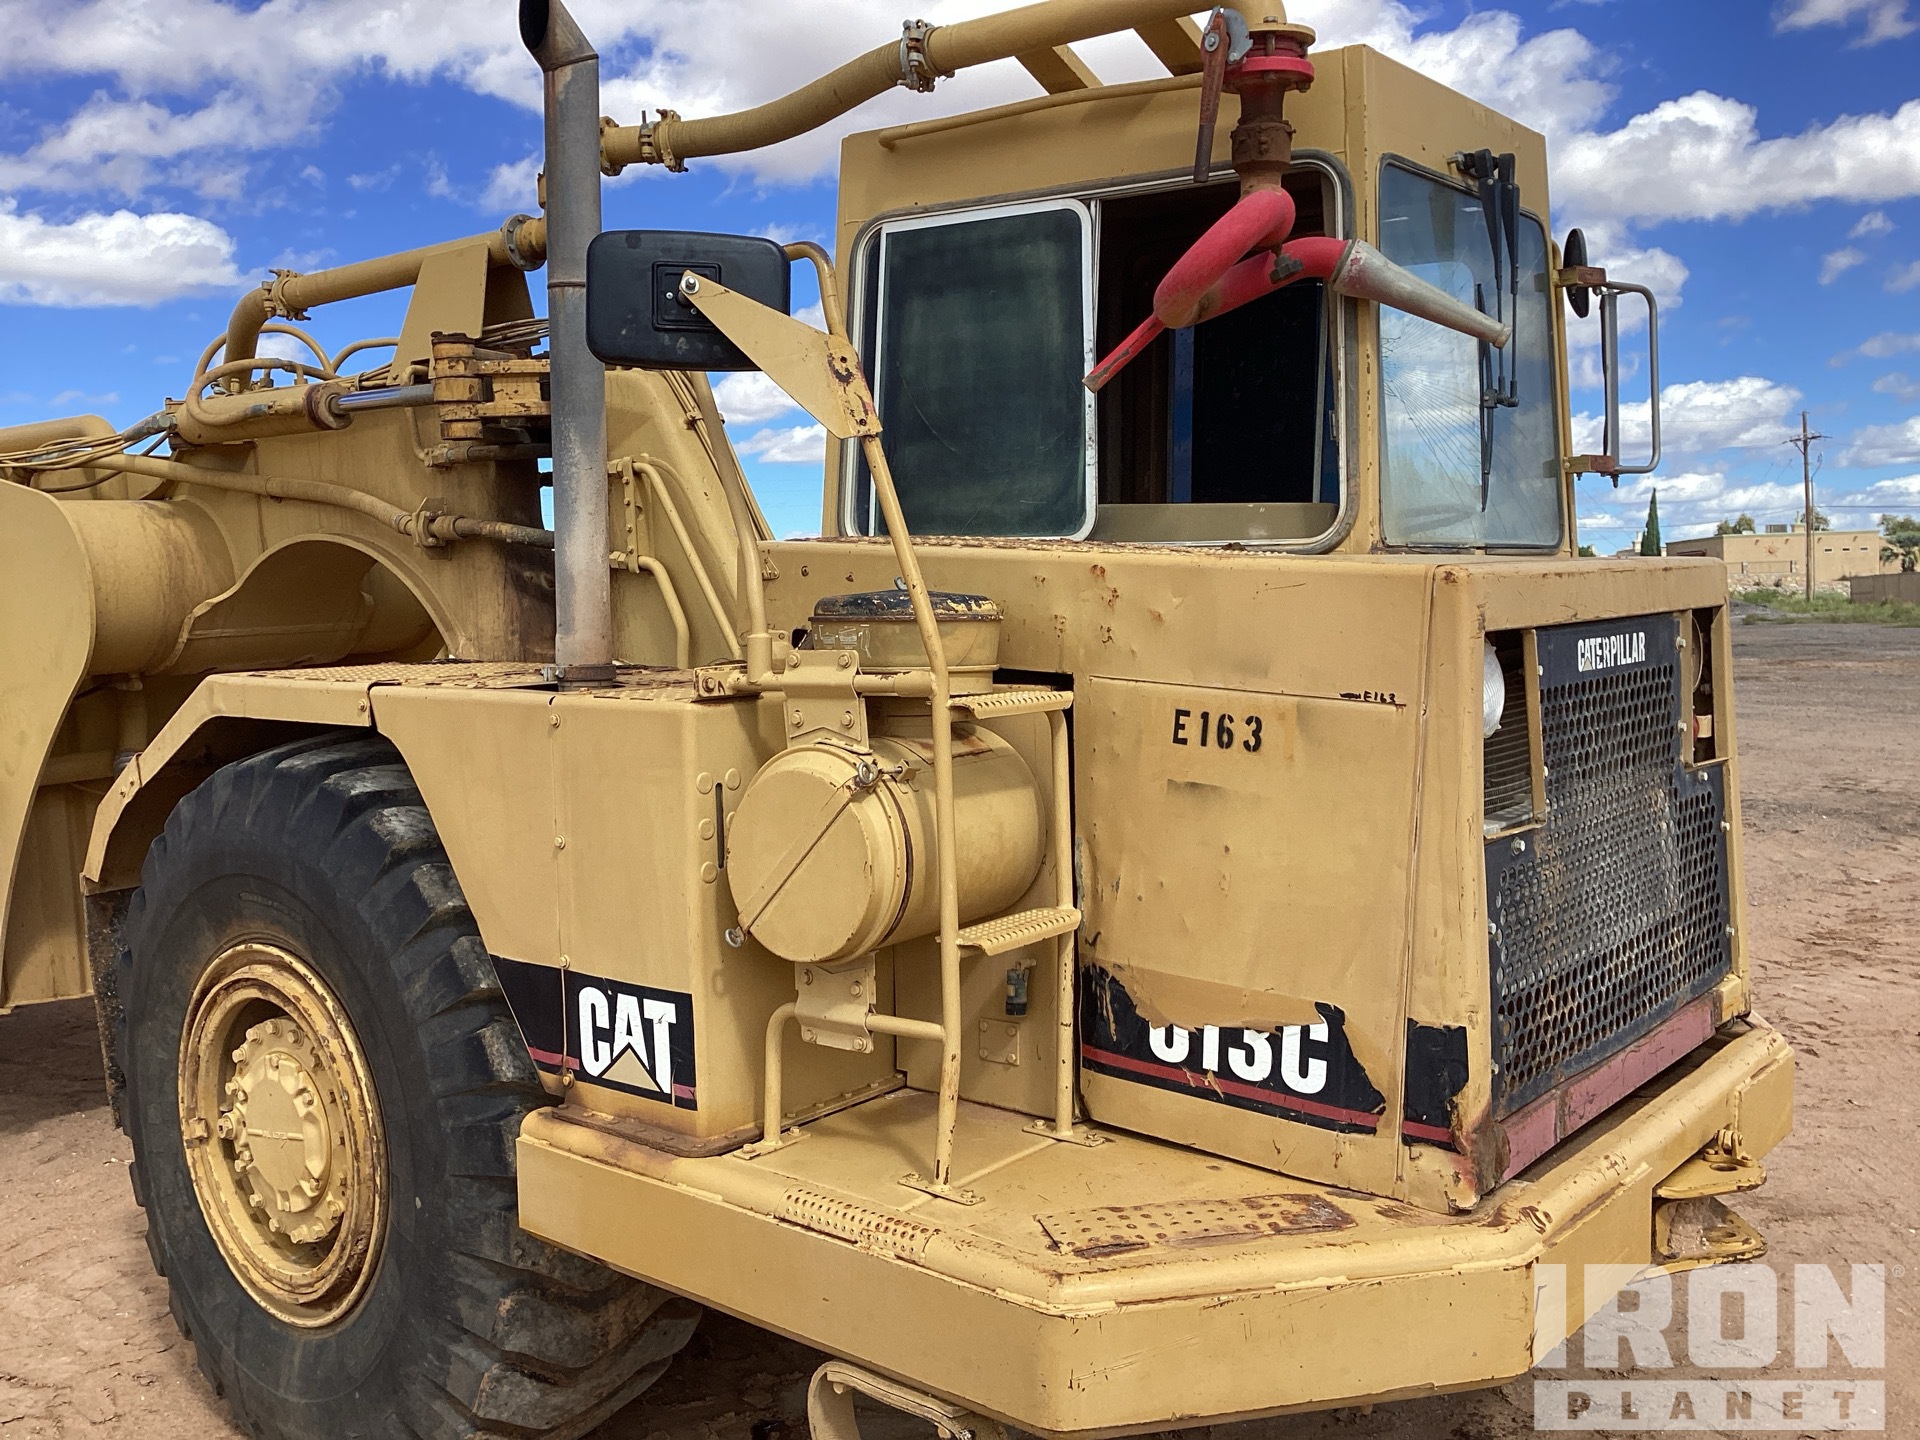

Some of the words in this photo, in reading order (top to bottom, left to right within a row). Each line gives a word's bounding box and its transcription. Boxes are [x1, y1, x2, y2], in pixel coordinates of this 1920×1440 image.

[1577, 631, 1646, 672] CATERPILLAR
[1172, 708, 1263, 752] E163
[578, 986, 677, 1094] CAT
